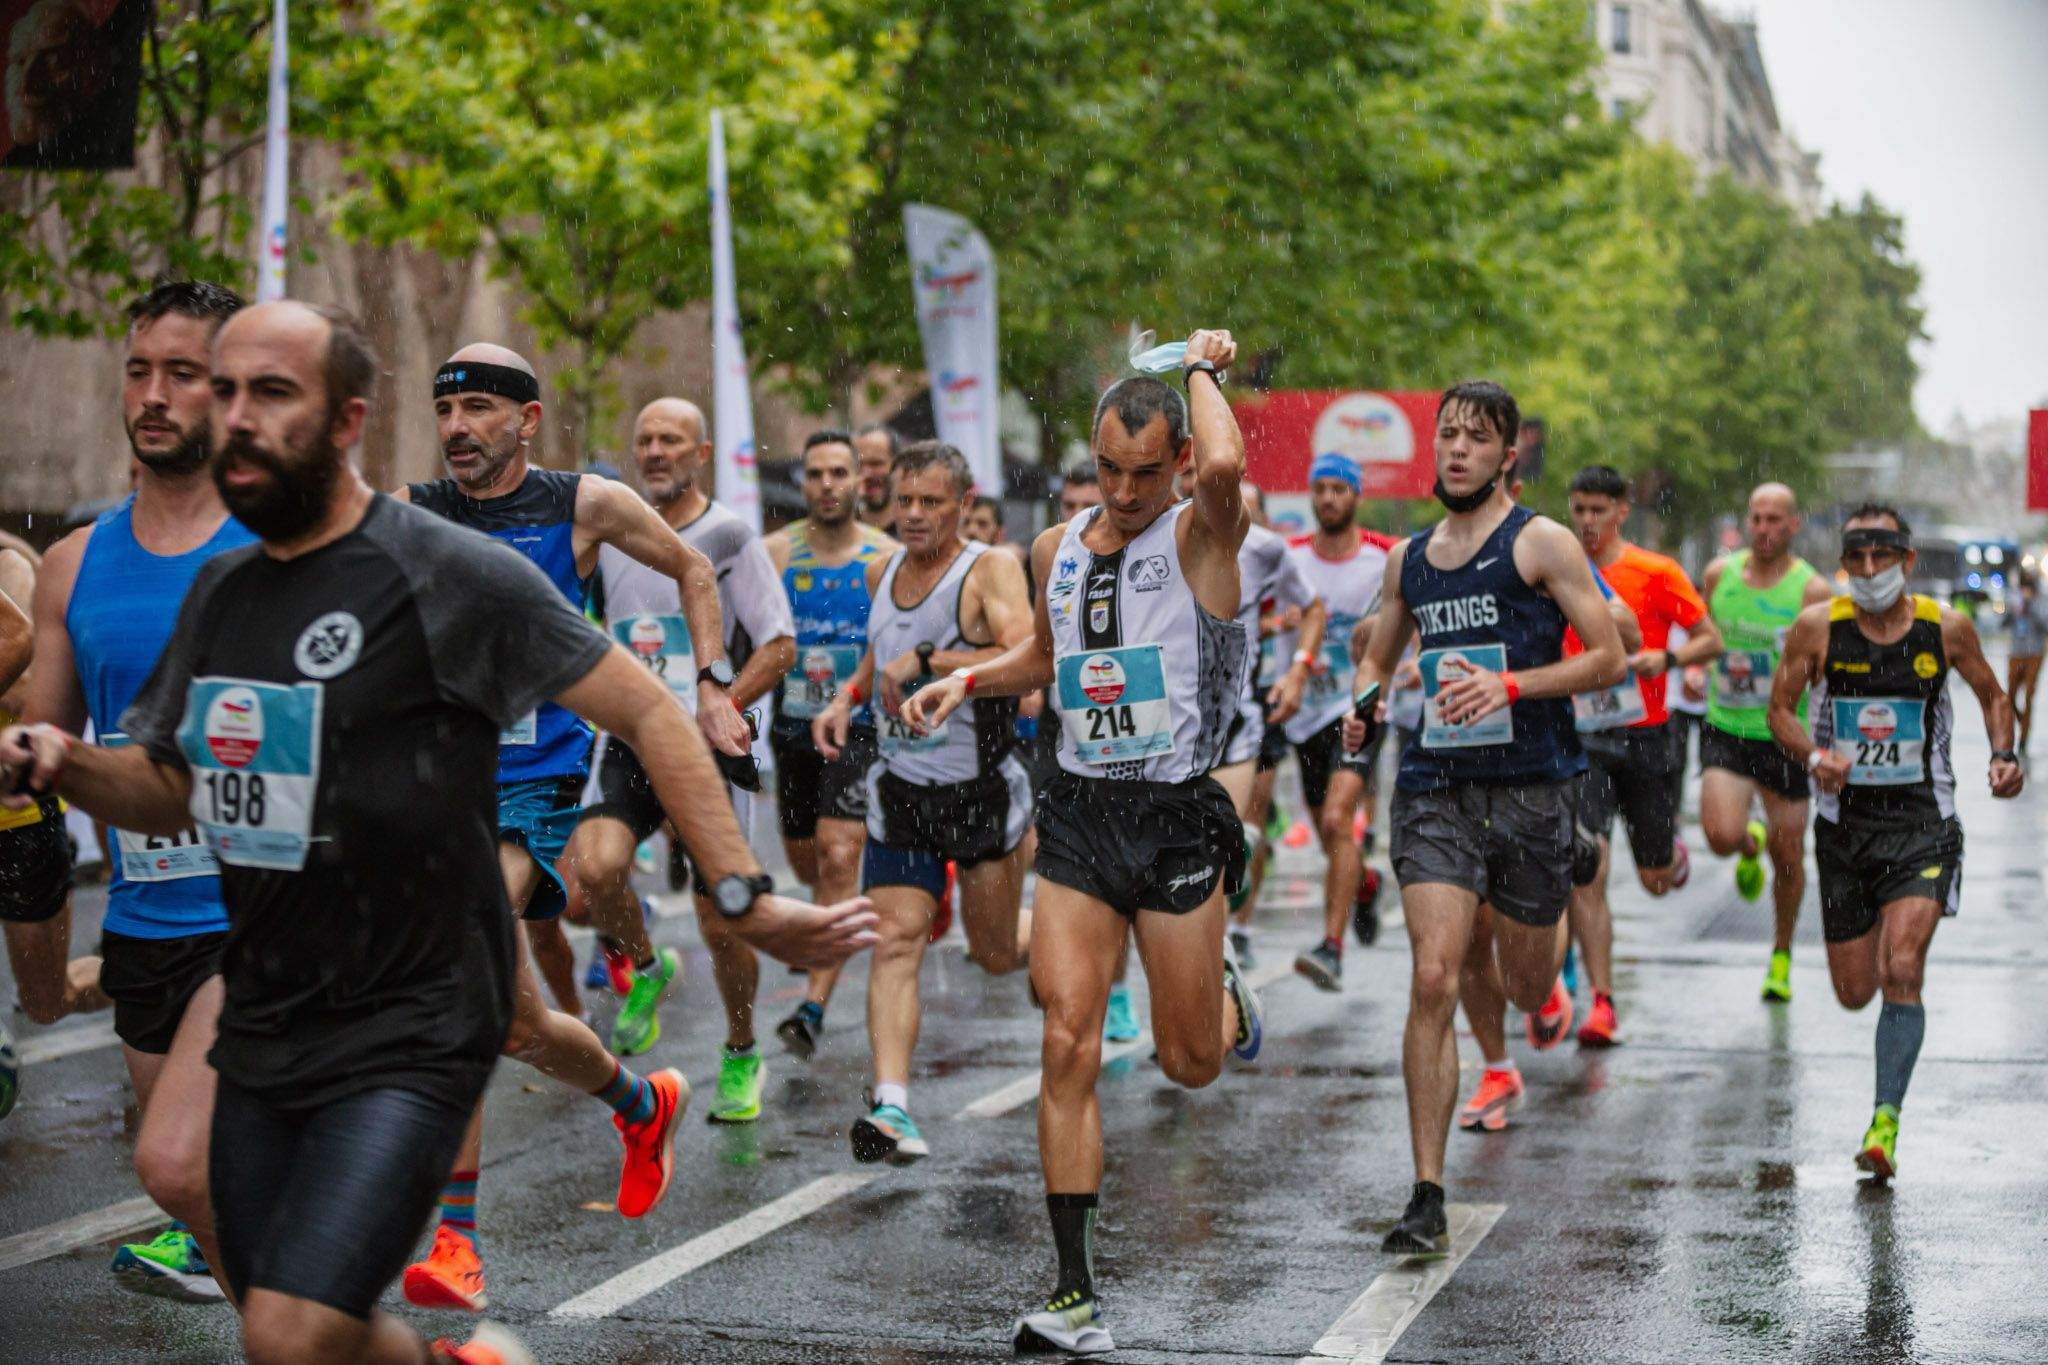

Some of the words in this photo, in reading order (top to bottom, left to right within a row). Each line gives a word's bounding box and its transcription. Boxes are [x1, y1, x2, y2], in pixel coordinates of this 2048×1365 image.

[1086, 704, 1137, 741] 214
[1856, 743, 1900, 766] 224
[206, 772, 265, 827] 198
